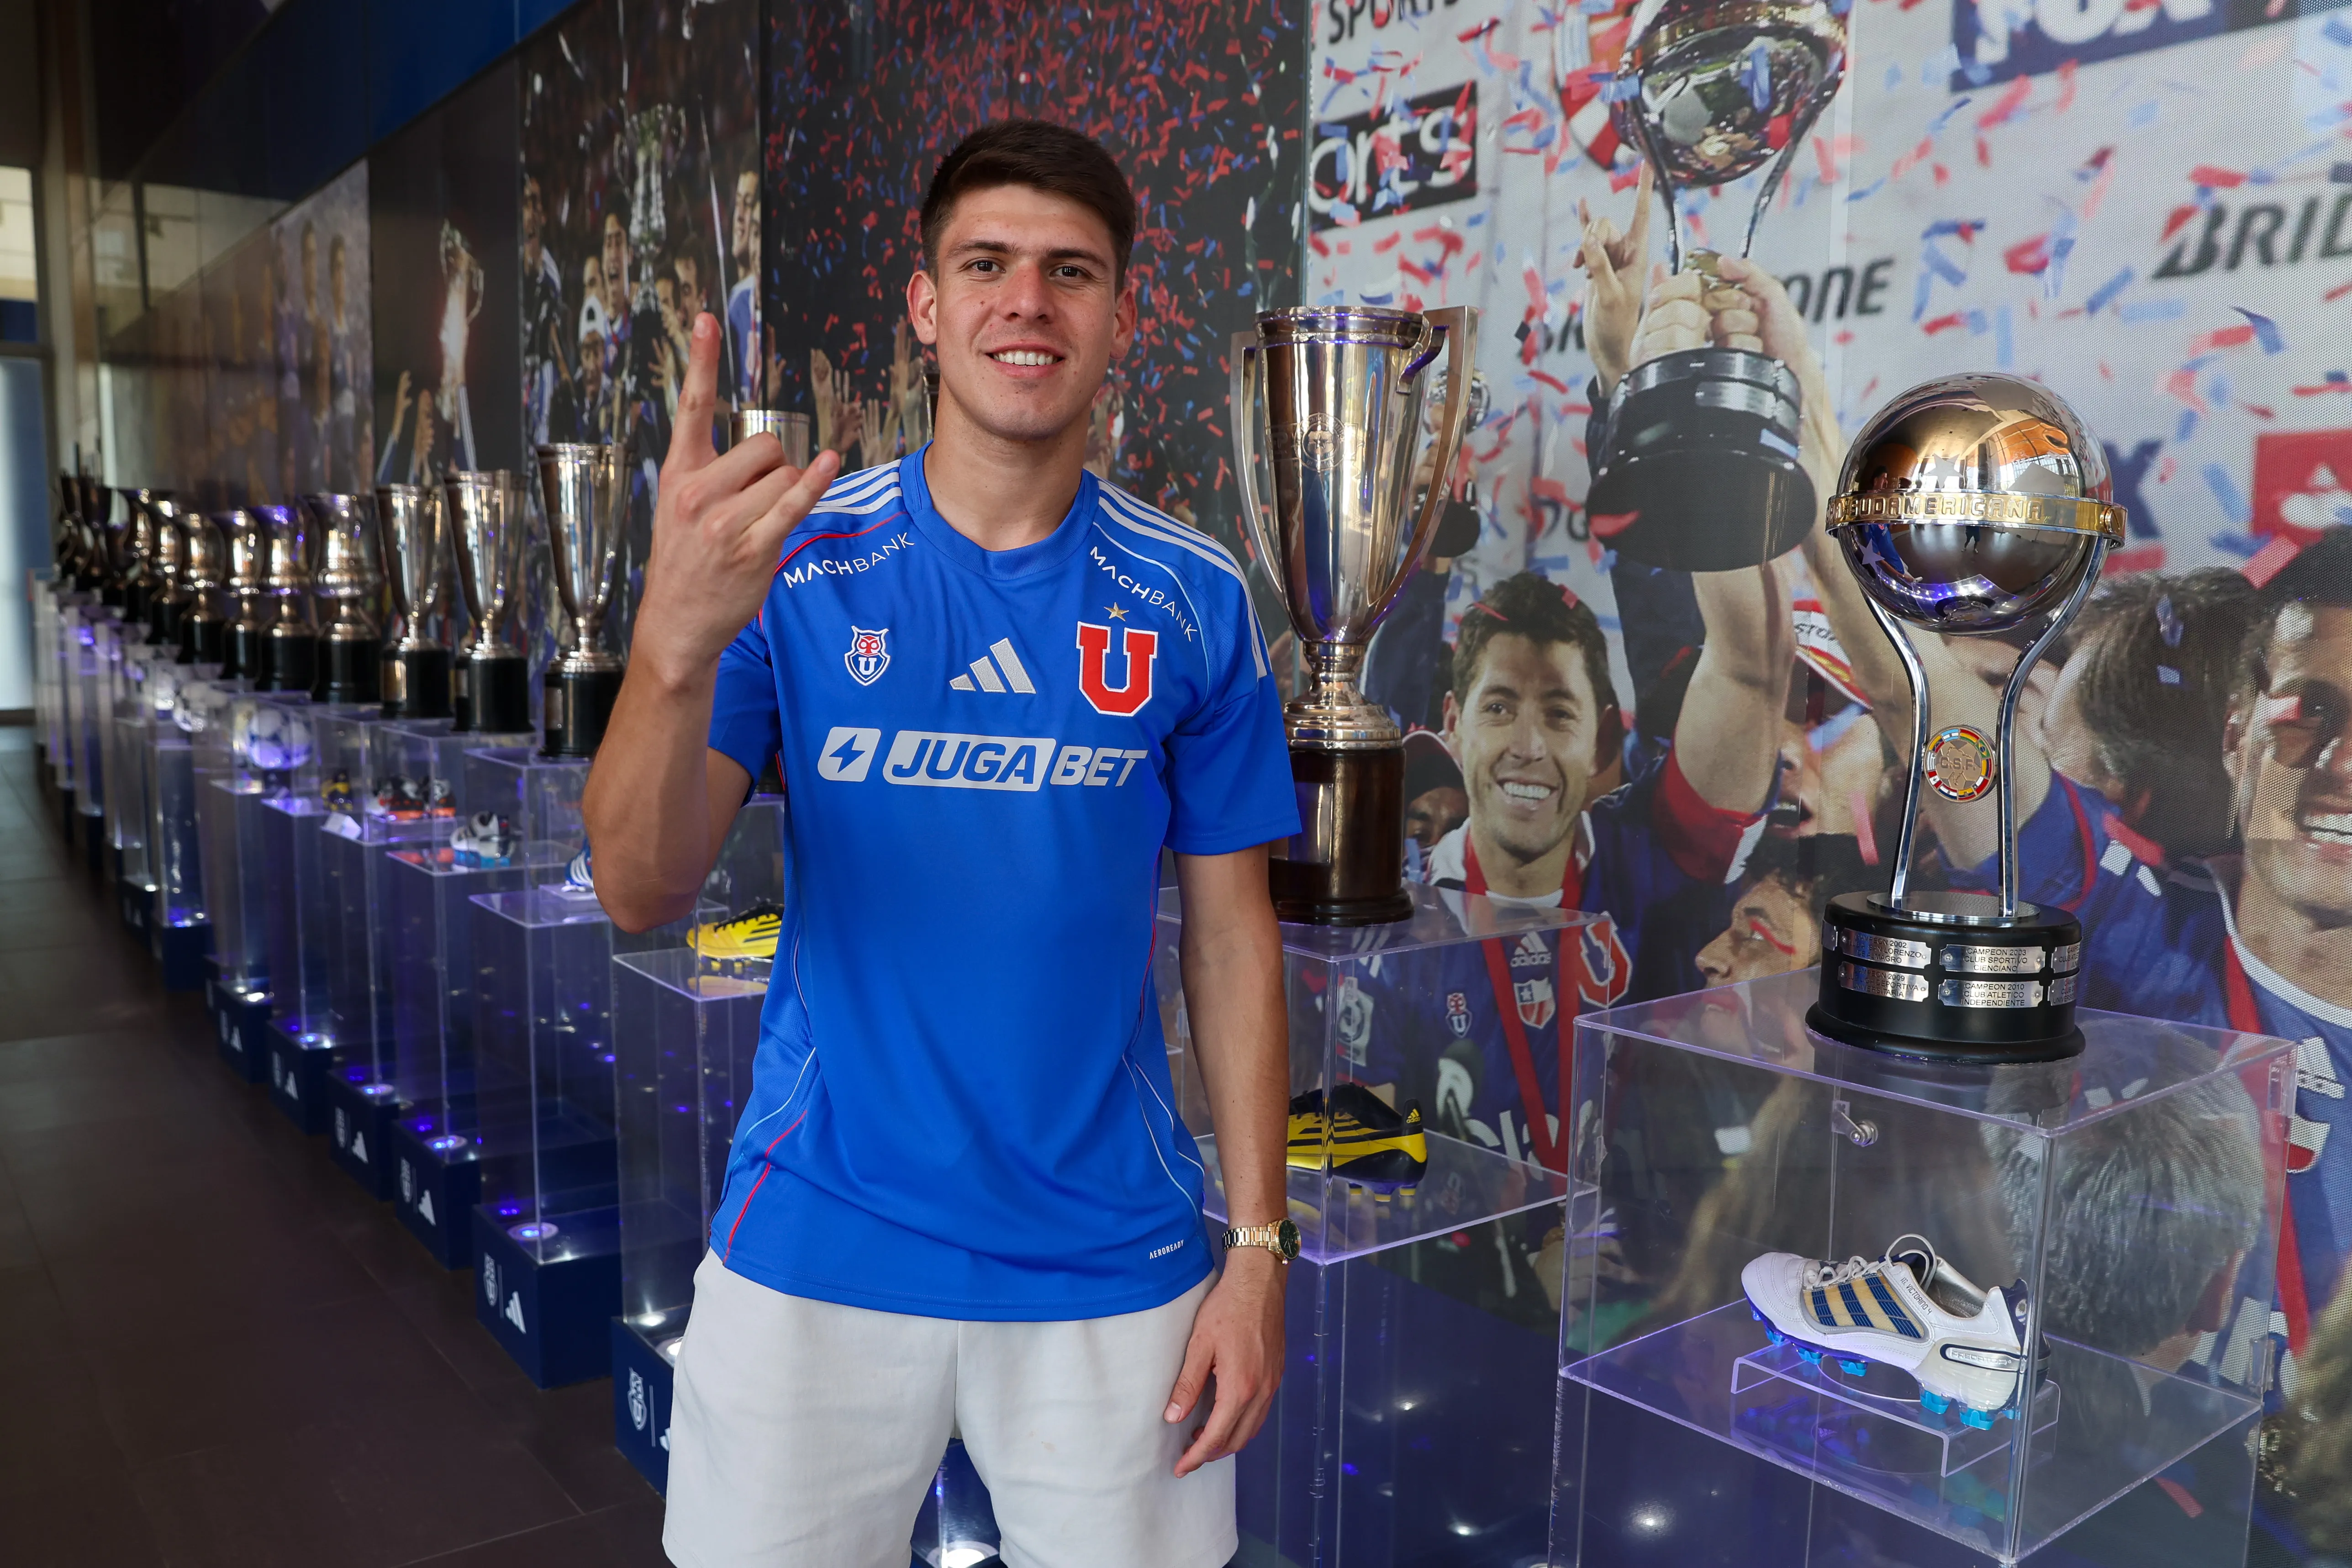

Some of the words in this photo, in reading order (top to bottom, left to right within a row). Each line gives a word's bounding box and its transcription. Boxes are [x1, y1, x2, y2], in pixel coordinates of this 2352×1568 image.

[1850, 496, 2042, 520] SUDAMERICANA
[783, 532, 915, 588] MACHBANK
[1090, 546, 1198, 642] MACHBANK
[858, 657, 877, 676] U
[1076, 621, 1159, 717] U
[1941, 756, 1976, 771] C.S.F.
[1867, 952, 1902, 963] ALMAGRO
[1884, 948, 1922, 958] LORENZO
[1876, 980, 1919, 991] DEPORTIVA
[1888, 973, 1905, 982] 2009
[1853, 983, 1904, 998] UNIVERSITARIA
[1149, 1239, 1184, 1260] AEROREADY
[1906, 1283, 1929, 1310] VICTORINO
